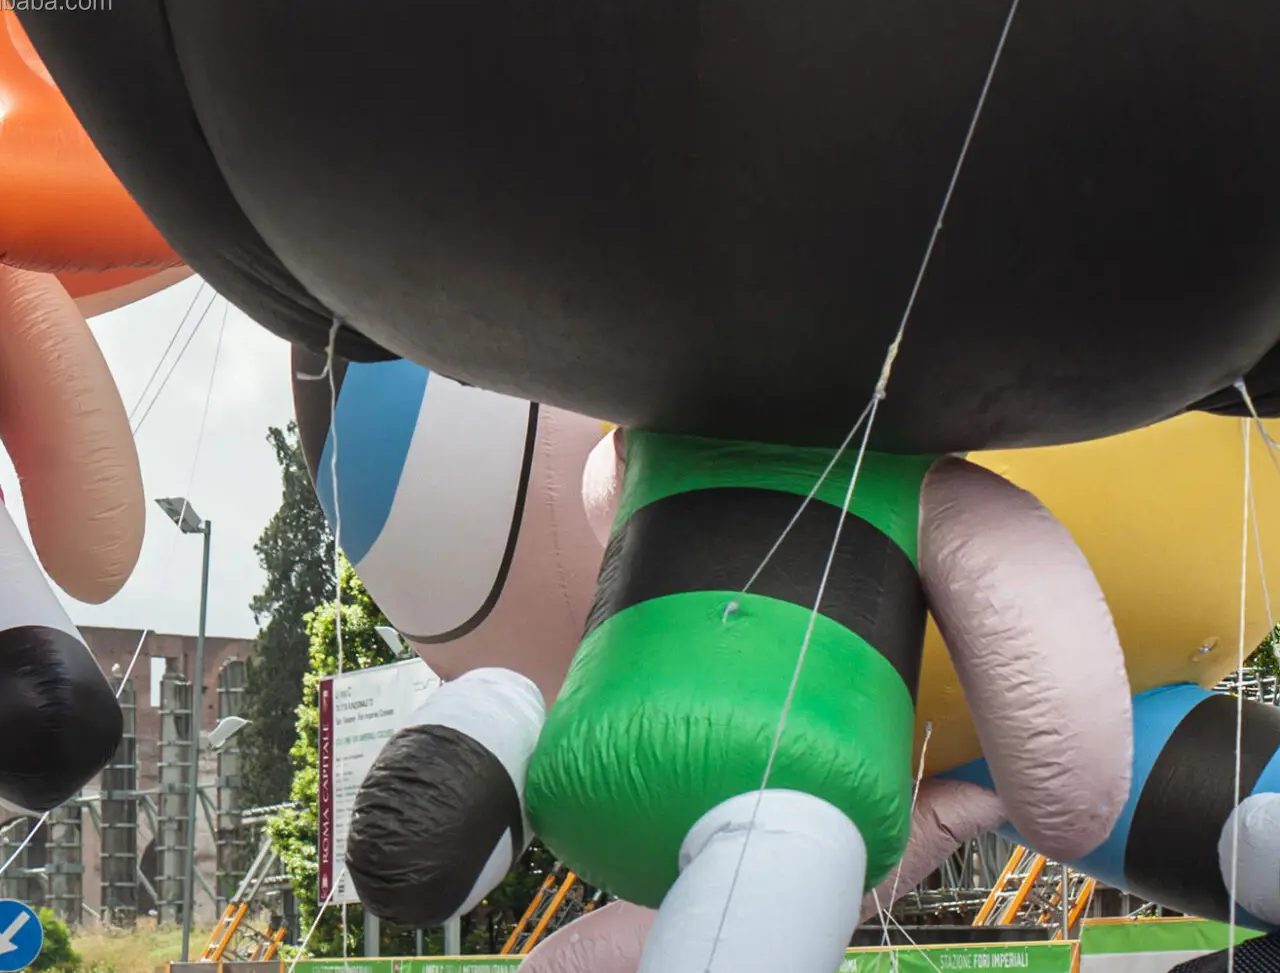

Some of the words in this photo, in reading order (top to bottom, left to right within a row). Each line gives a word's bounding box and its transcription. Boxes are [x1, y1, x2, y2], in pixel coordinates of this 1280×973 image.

[322, 724, 330, 803] CAPITALE
[322, 807, 330, 864] ROMA
[940, 954, 972, 969] STAZIONE
[973, 953, 991, 968] FORI
[992, 952, 1029, 968] IMPERIALI
